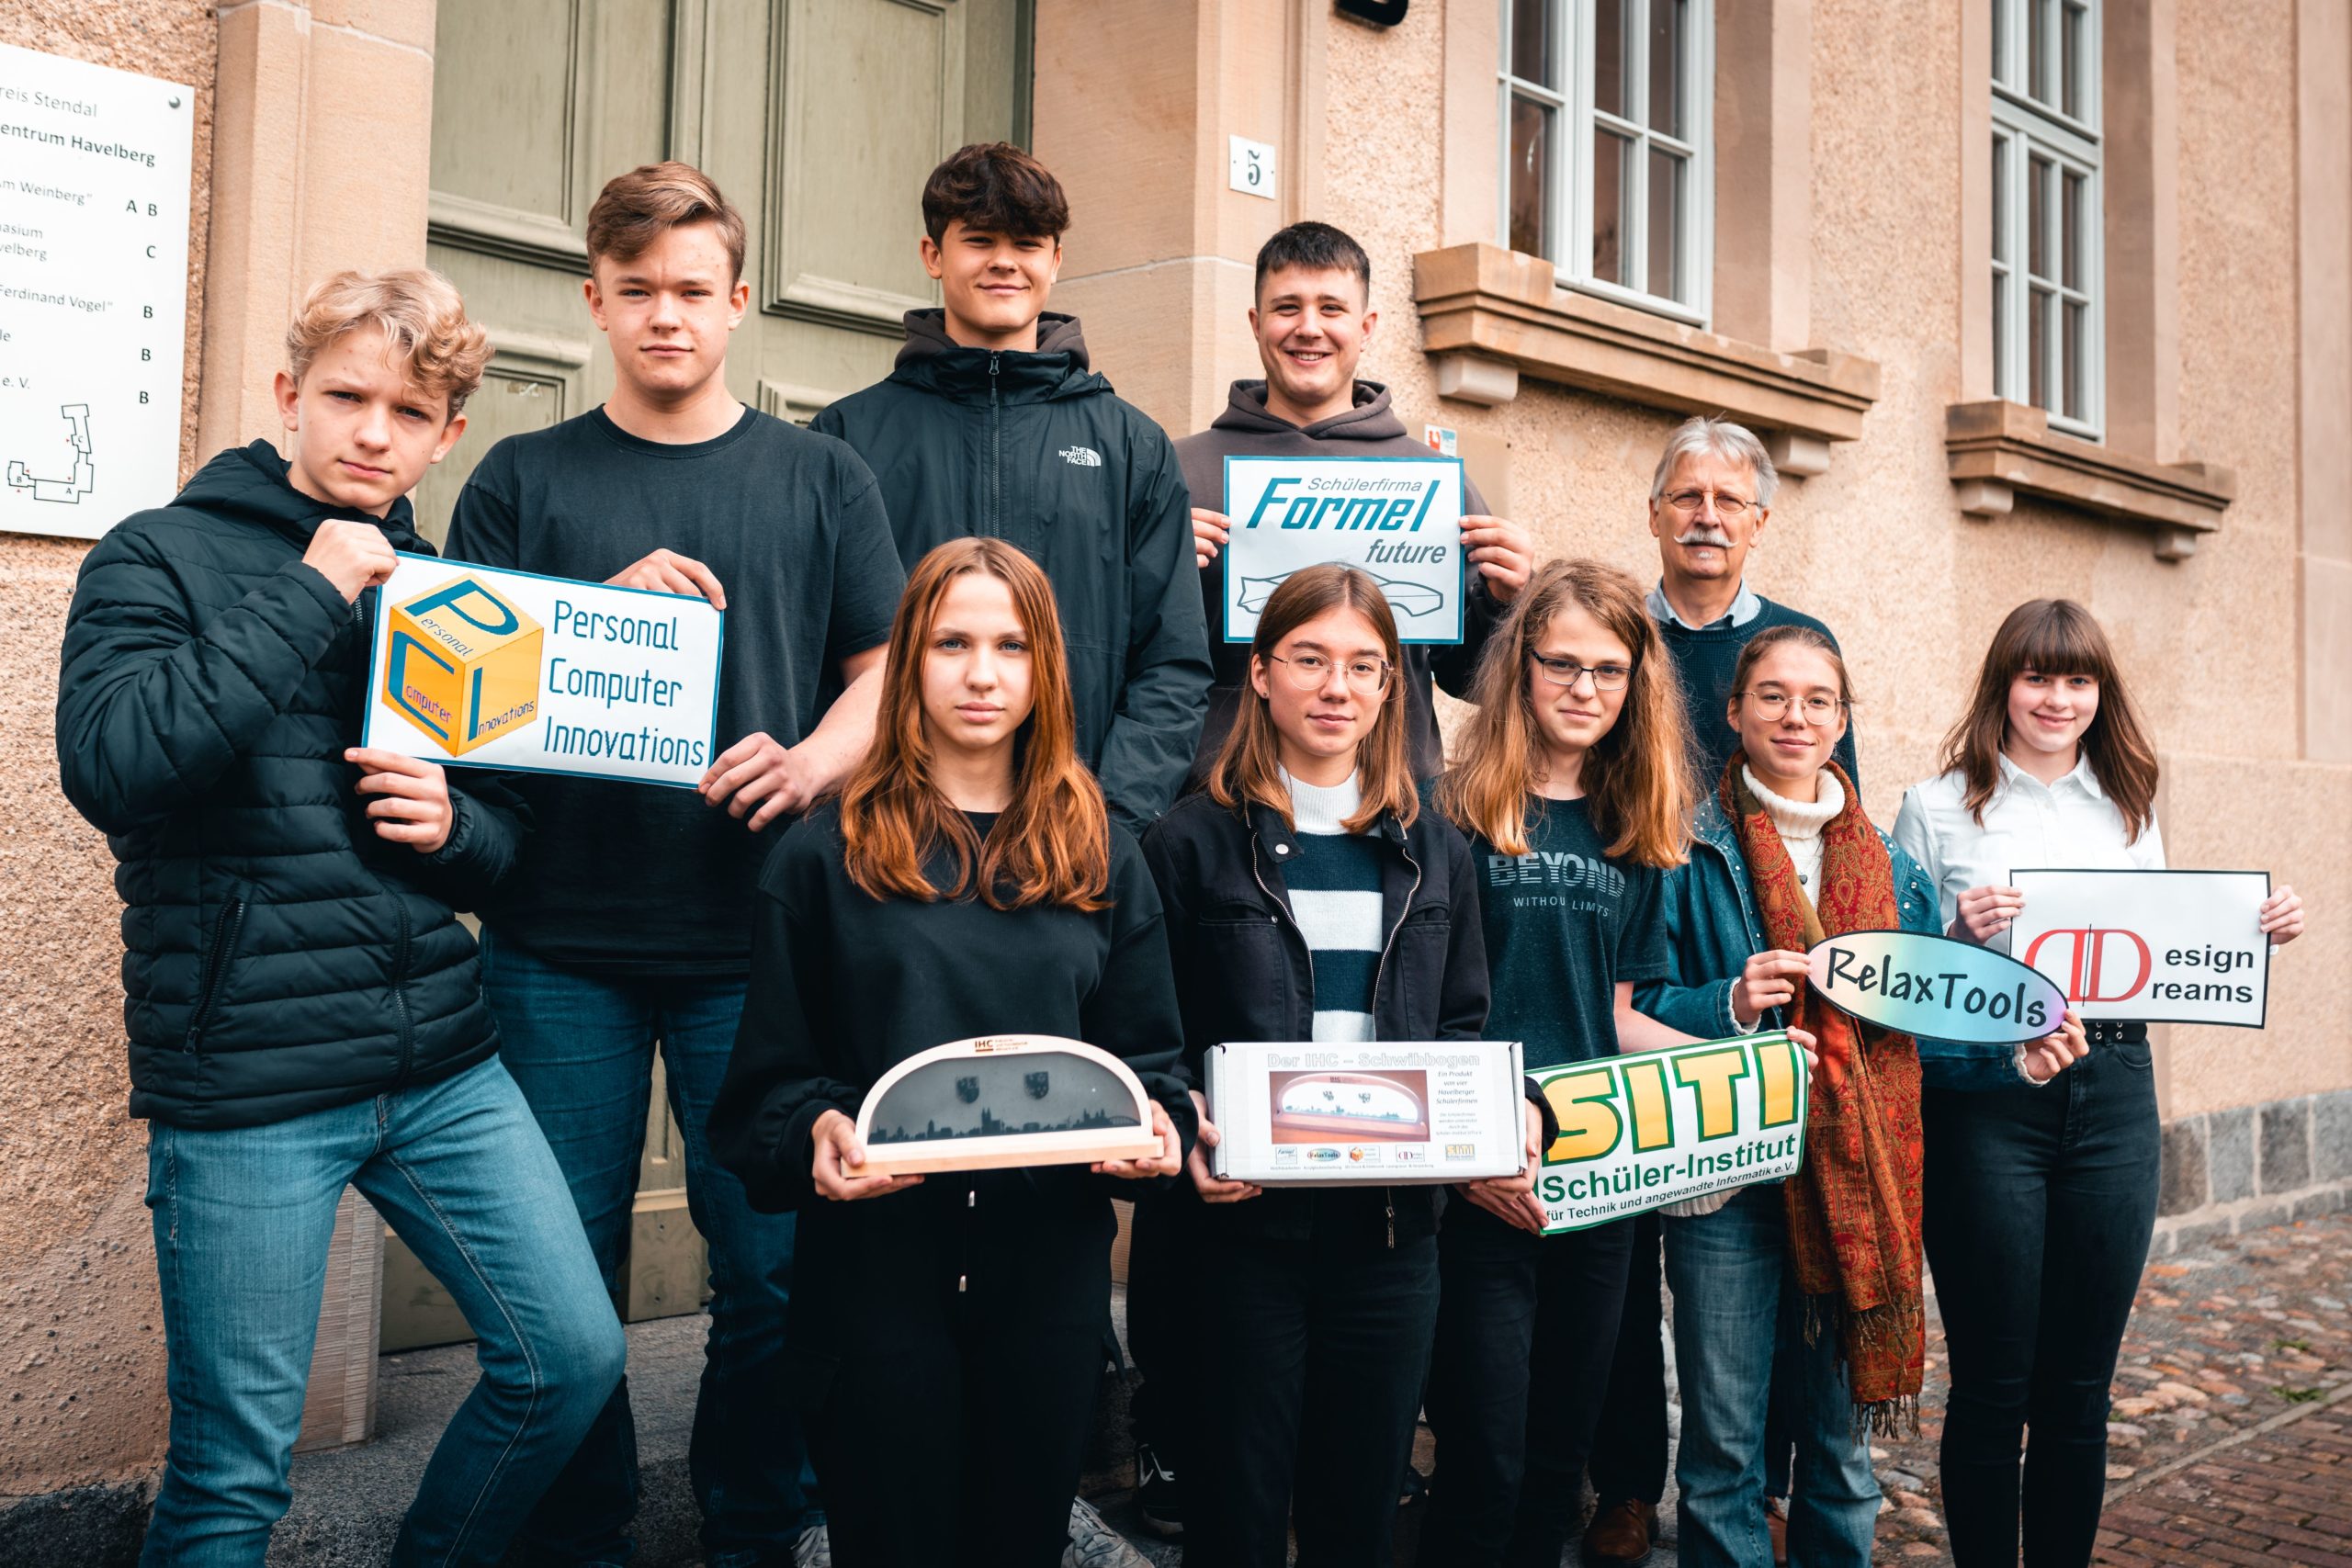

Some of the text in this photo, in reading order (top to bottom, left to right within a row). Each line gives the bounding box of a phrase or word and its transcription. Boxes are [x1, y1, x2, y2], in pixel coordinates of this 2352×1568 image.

[34, 90, 97, 118] Stendal
[72, 135, 155, 167] Havelberg
[1248, 150, 1261, 186] 5
[126, 199, 158, 217] A B
[146, 245, 156, 258] C
[143, 306, 153, 319] B
[141, 348, 152, 362] B
[140, 391, 150, 404] B
[1058, 449, 1087, 459] NORTH
[1067, 457, 1087, 466] FACE
[1307, 477, 1423, 492] Schülerfirma
[1246, 477, 1442, 532] Formel
[1365, 538, 1447, 564] future
[554, 599, 679, 651] Personal
[548, 657, 683, 709] Computer
[543, 716, 705, 767] Innovations
[1487, 851, 1625, 898] BEYOND
[1513, 896, 1610, 918] WITHOU LIMTS
[2165, 944, 2254, 974] esign
[1826, 947, 2047, 1028] RelaxTools
[2152, 982, 2254, 1004] reams
[975, 1040, 994, 1049] IHC
[1267, 1053, 1300, 1068] Der
[1305, 1053, 1340, 1068] IHC
[1358, 1052, 1481, 1069] Schwibbogen
[1540, 1039, 1800, 1167] SITI
[1542, 1133, 1796, 1203] Schüler-Institut
[1546, 1210, 1564, 1222] für
[1566, 1202, 1617, 1220] Technik
[1620, 1196, 1643, 1210] und
[1645, 1181, 1714, 1205] angewandte
[1716, 1168, 1772, 1188] Informatik
